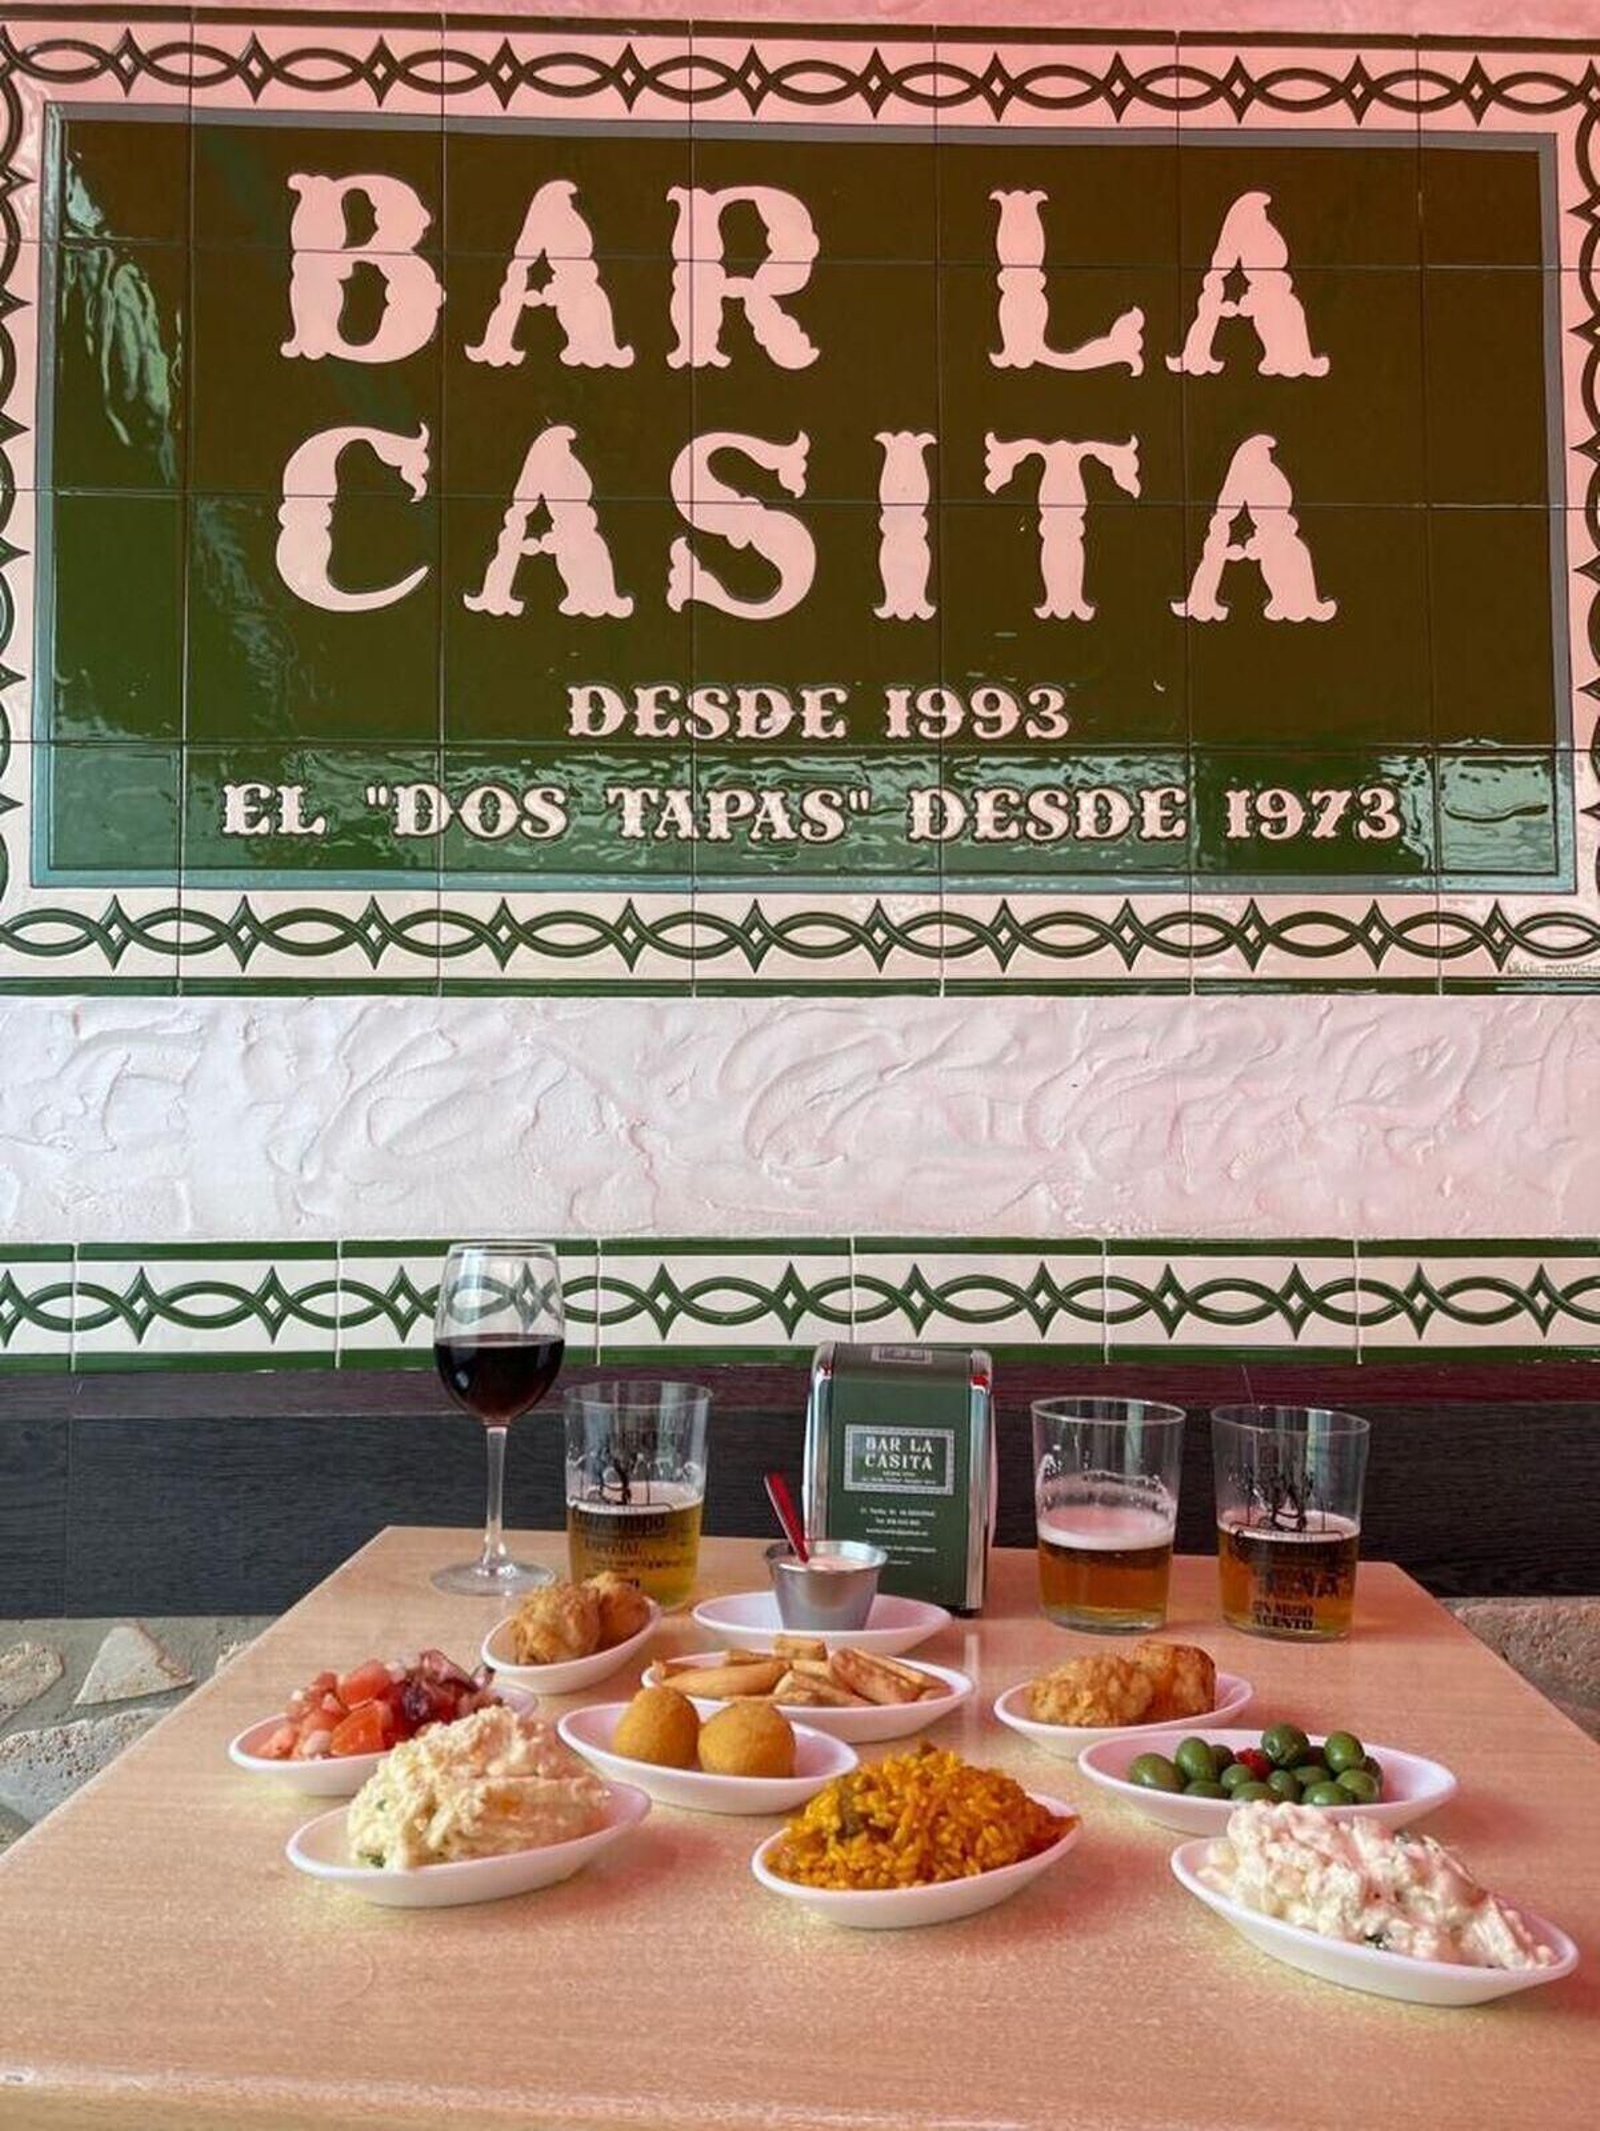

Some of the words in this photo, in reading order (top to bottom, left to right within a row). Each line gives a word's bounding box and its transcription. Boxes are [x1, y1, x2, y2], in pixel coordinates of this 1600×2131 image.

[280, 173, 820, 370] BAR
[988, 190, 1331, 377] LA
[275, 421, 1338, 622] CASITA
[567, 684, 848, 740] DESDE
[885, 686, 1069, 740] 1993
[222, 783, 326, 836] EL
[365, 783, 568, 839] "DOS
[602, 785, 871, 842] TAPAS"
[907, 788, 1188, 842] DESDE
[1225, 787, 1402, 840] 1973
[864, 1453, 933, 1471] CASITA
[865, 1435, 901, 1452] BAR
[910, 1437, 934, 1454] LA
